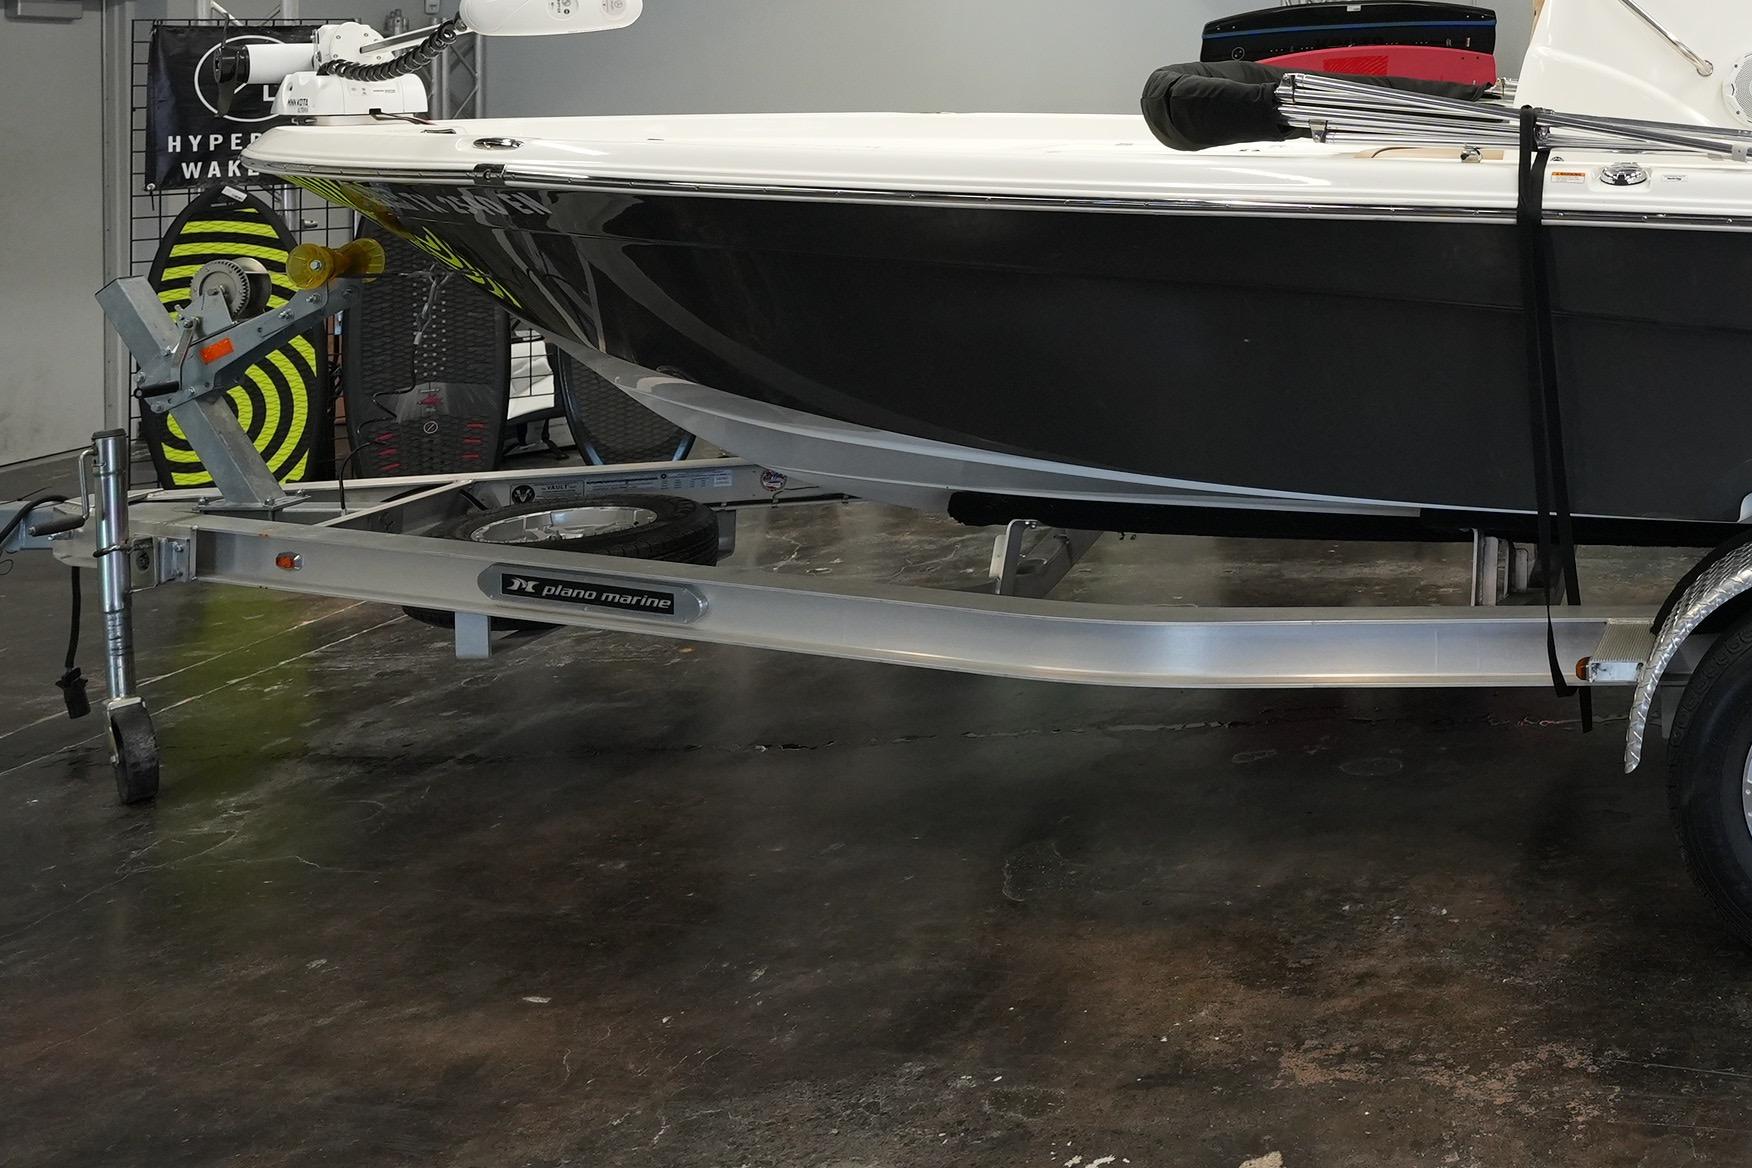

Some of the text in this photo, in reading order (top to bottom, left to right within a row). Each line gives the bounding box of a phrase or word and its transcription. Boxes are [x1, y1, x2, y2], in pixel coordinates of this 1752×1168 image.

[181, 160, 260, 179] WAK
[541, 584, 672, 610] plano marine
